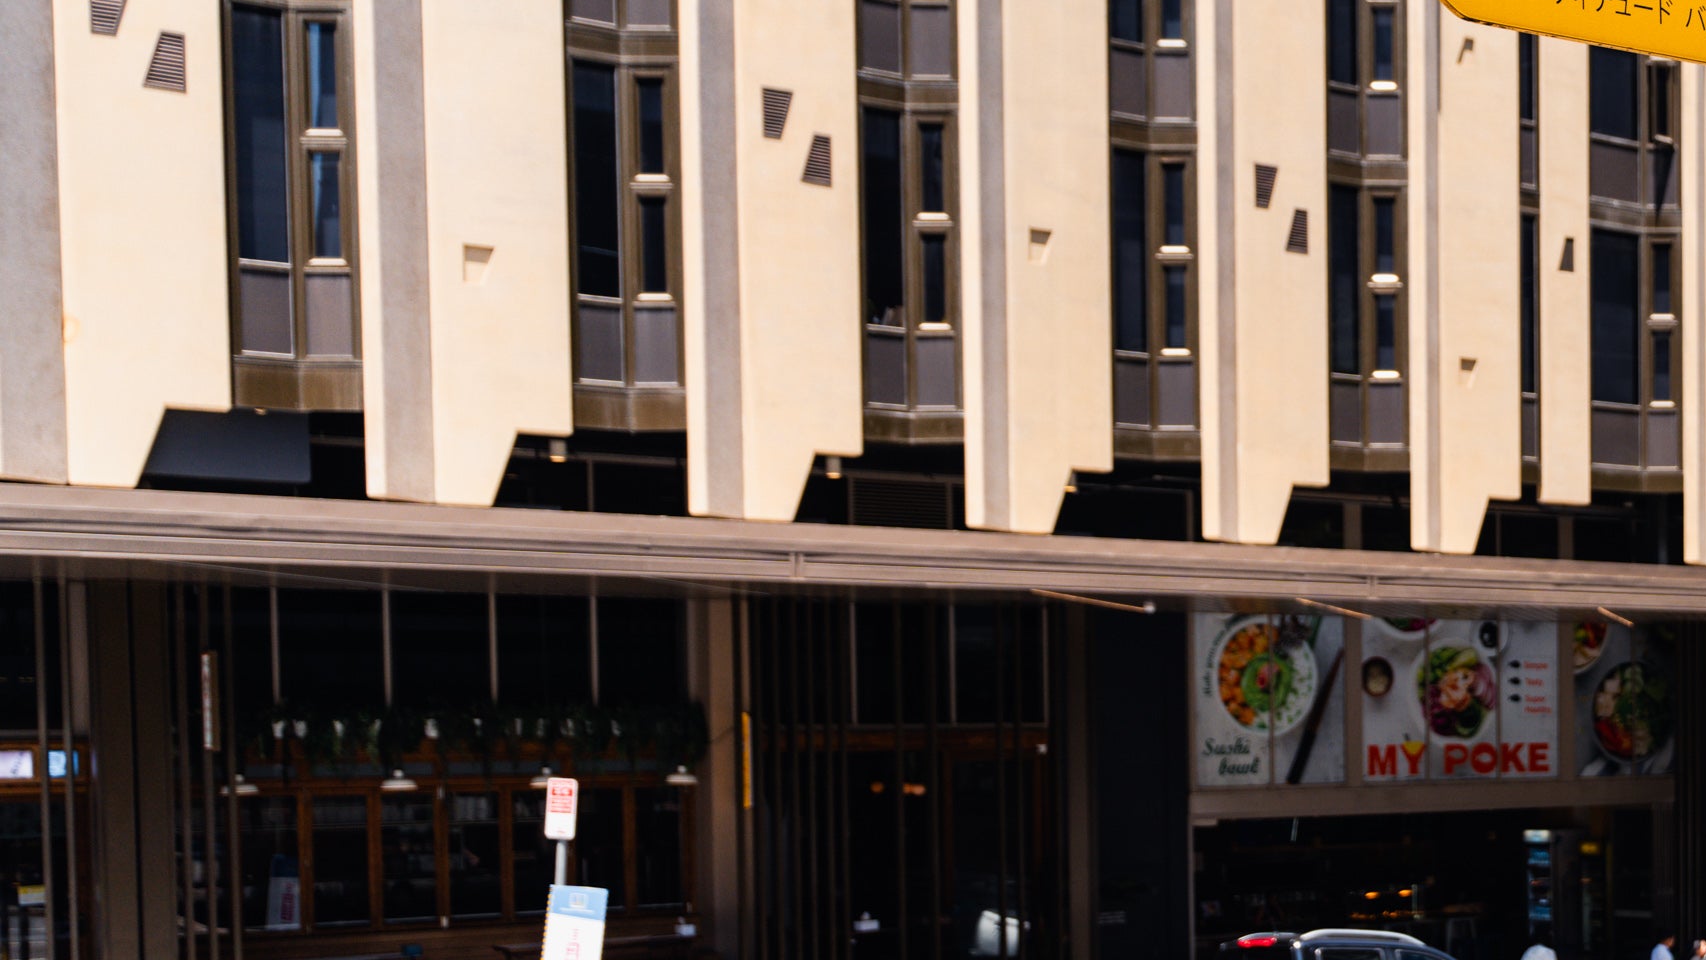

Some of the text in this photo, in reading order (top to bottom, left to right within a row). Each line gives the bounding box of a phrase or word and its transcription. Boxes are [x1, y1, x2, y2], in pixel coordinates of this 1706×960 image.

[1202, 738, 1251, 756] Sushi
[1218, 757, 1260, 775] bowl
[1367, 742, 1550, 776] MY POKE
